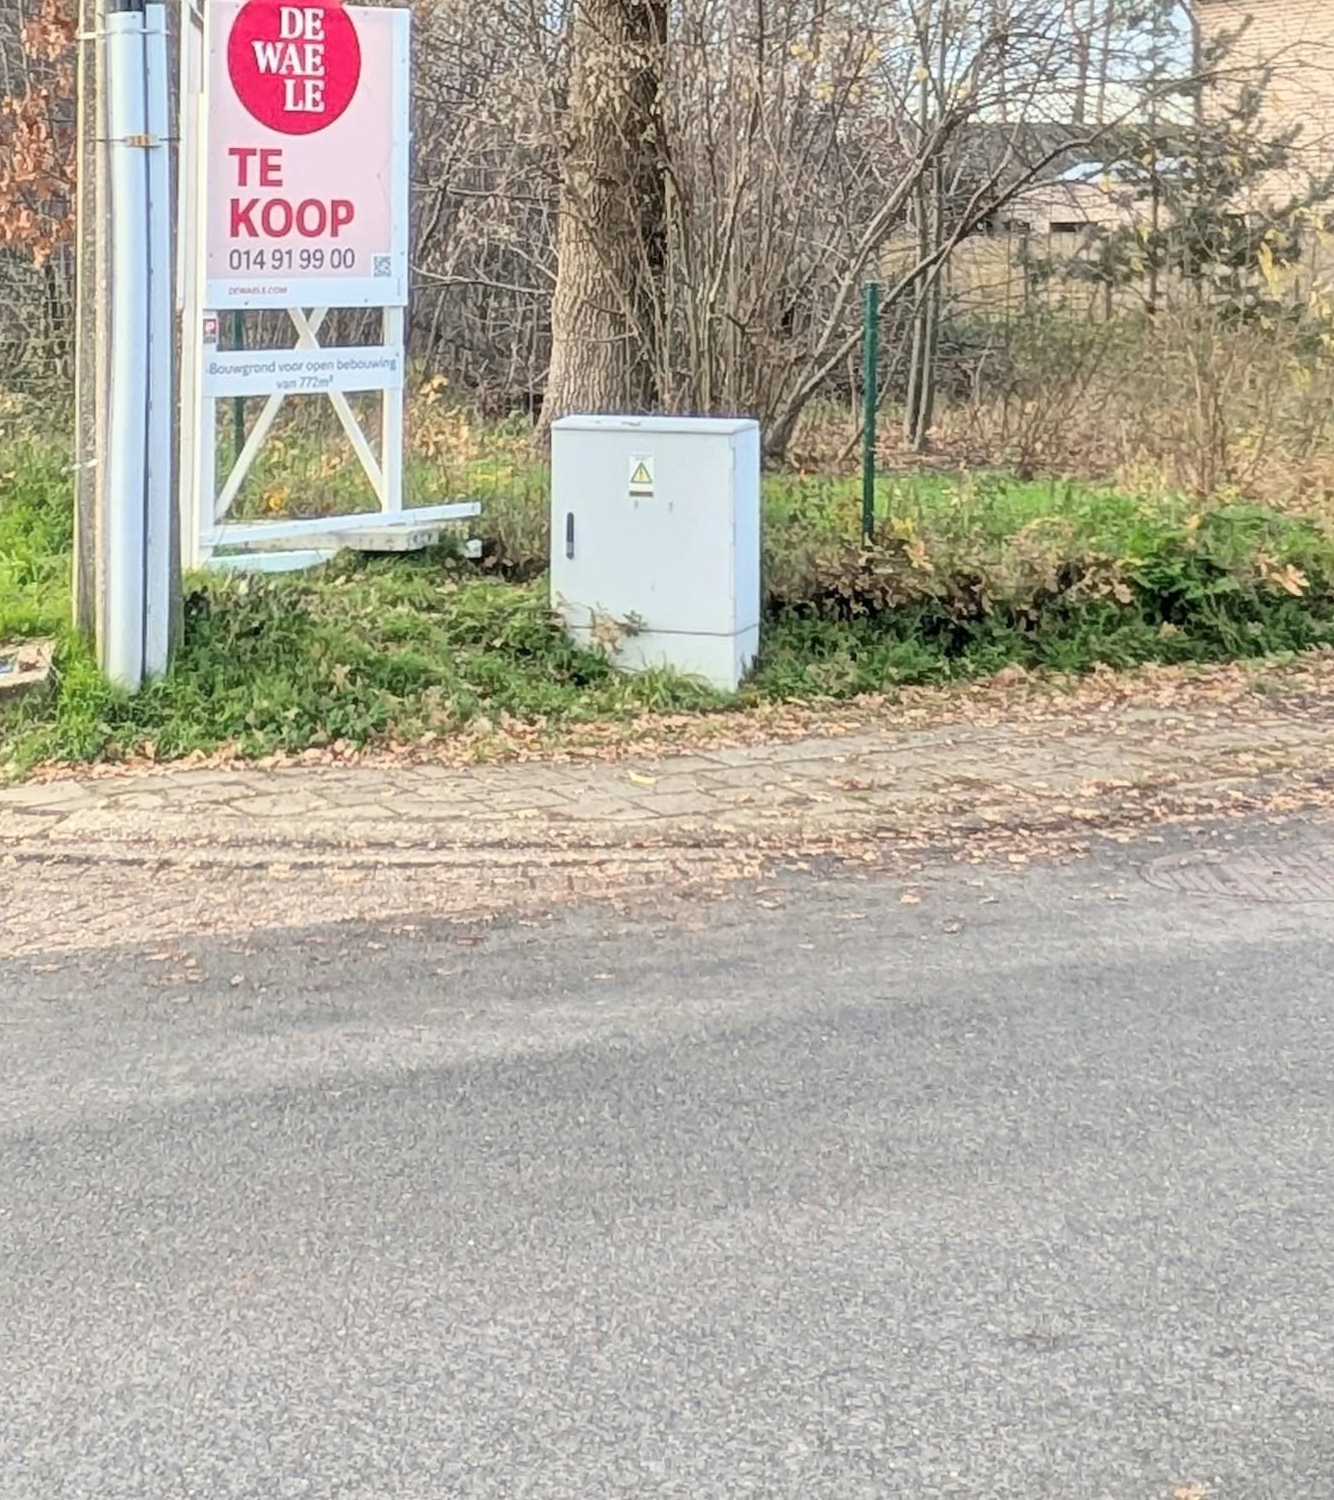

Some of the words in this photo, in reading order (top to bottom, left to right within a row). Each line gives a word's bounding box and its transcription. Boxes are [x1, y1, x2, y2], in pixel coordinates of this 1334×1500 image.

[279, 6, 325, 41] DE
[251, 40, 325, 77] WAE
[283, 78, 325, 113] LE
[228, 147, 283, 187] TE
[229, 197, 355, 238] KOOP
[229, 248, 266, 271] 014
[271, 248, 293, 271] 91
[299, 248, 325, 270] 99
[330, 247, 356, 270] 00
[209, 360, 276, 377] Bouwgrond
[278, 362, 303, 373] voor
[305, 361, 335, 373] open
[336, 356, 397, 371] bebouwing
[275, 379, 297, 389] van
